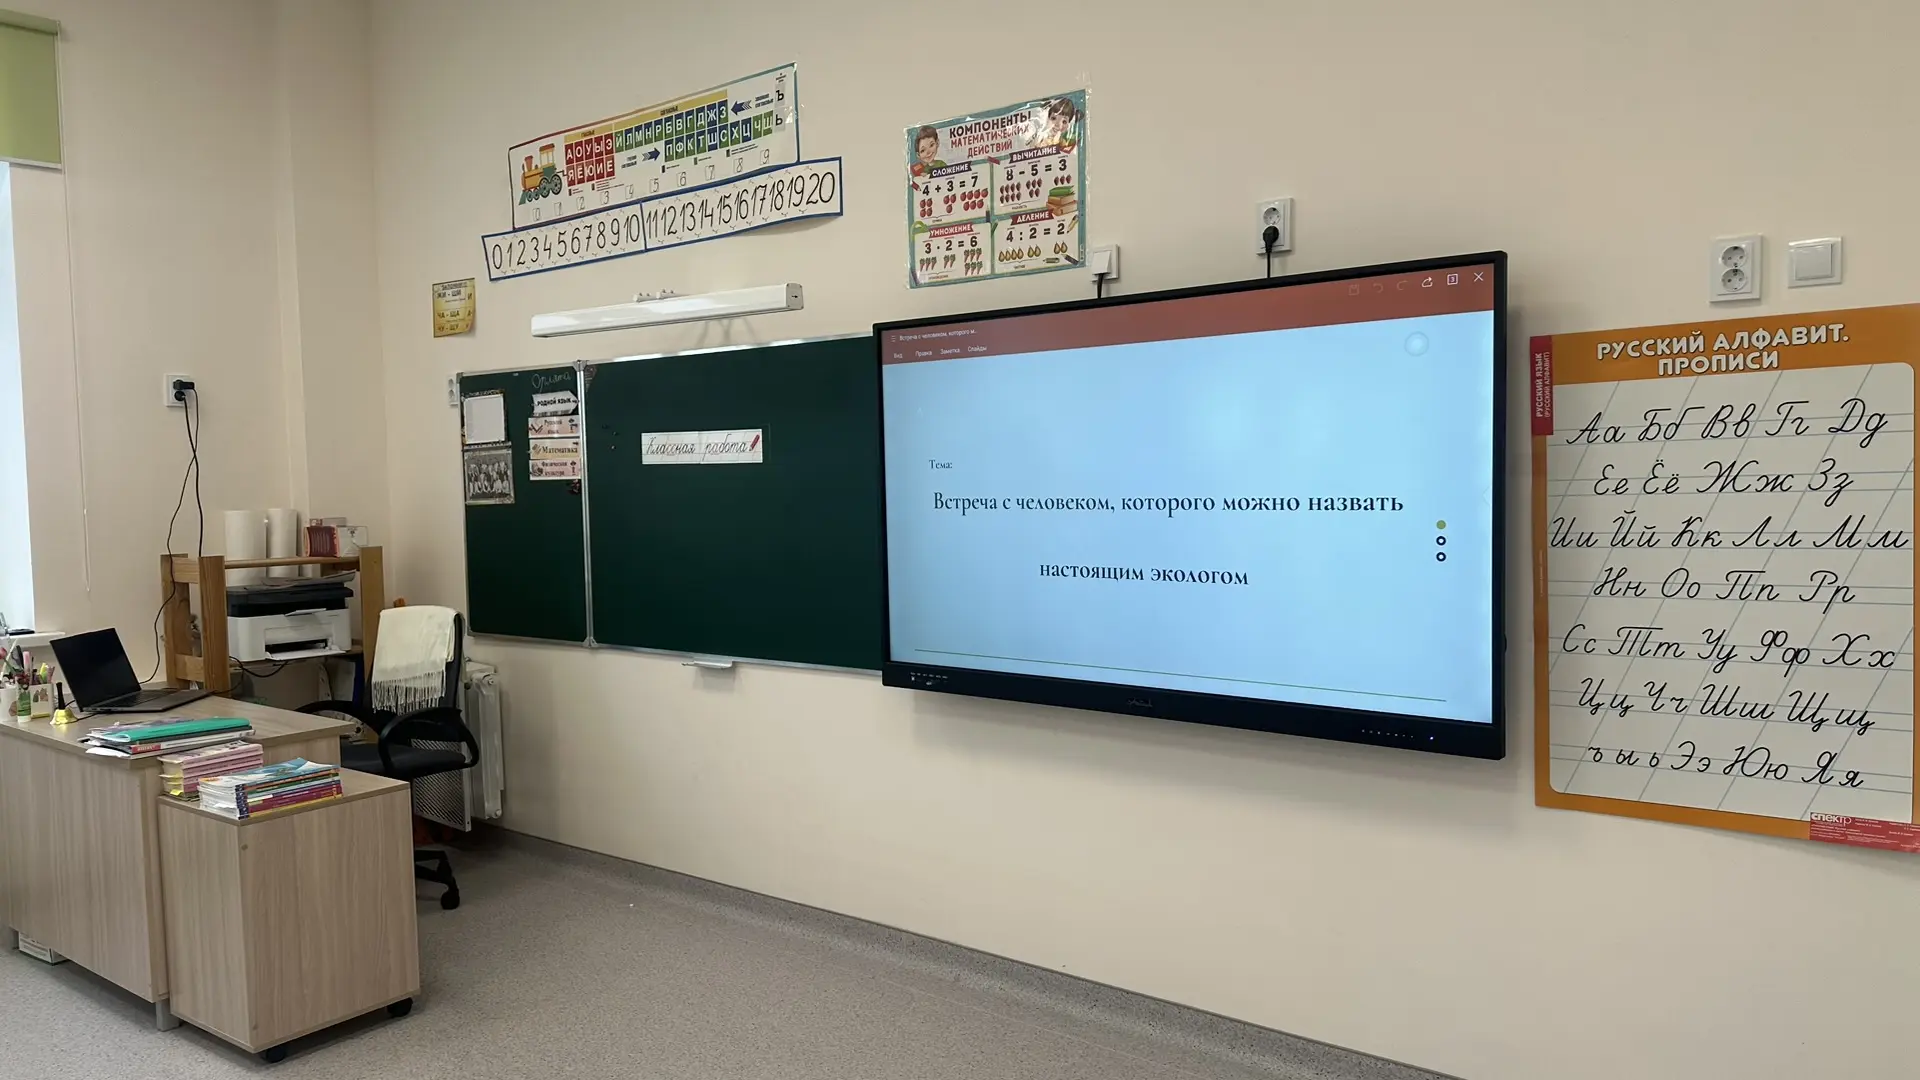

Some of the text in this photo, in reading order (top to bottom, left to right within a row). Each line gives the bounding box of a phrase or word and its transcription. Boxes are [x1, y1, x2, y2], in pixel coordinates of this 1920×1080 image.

[950, 111, 1031, 138] КОМПОНЕНТЫ
[951, 123, 1030, 149] МАТЕМАТИЧЕСКИХ
[967, 139, 1013, 159] ДЕЙСТВИЙ
[1012, 146, 1057, 161] ВЫЧИТАНИЕ
[932, 163, 969, 177] СЛОЖЕНИЕ
[1006, 168, 1014, 181] 8
[1031, 164, 1039, 176] 5
[1059, 159, 1067, 171] 3
[922, 184, 930, 196] 4
[947, 180, 954, 192] 3
[971, 175, 978, 187] 7
[492, 171, 836, 269] 0 1 2 3 4 5 6 7 8 9 10 11 12 13 14 15 16 17 18 19 20
[1016, 211, 1049, 223] ДЕЛЕНИЕ
[930, 224, 971, 236] УМНОЖЕНИЕ
[1006, 230, 1014, 242] 4
[1029, 227, 1037, 239] 2
[925, 242, 932, 254] 3
[945, 240, 953, 251] 2
[970, 236, 977, 247] 6
[1597, 323, 1849, 360] РУССКИЙ АЛФАВИТ.
[915, 350, 933, 358] Правка
[1658, 351, 1779, 376] ПРОПИСИ
[1535, 353, 1543, 418] РУССКИЙ ЯЗЫК
[537, 397, 557, 406] РОДНОЙ
[1566, 398, 1889, 449] Аа Бб Вв Гг Дд
[541, 445, 578, 454] Математика
[646, 433, 747, 461] Классная работа
[929, 459, 953, 470] Тема:
[1593, 464, 1629, 496] Ее
[1642, 459, 1680, 495] Ёё
[1807, 457, 1854, 508] Зз
[933, 492, 1404, 518] Встреча с человеком, которого можно назвать
[1550, 516, 1599, 548] Ии
[1610, 510, 1661, 548] Йй
[1671, 515, 1723, 548] Кк
[1040, 564, 1249, 585] настоящим экологом
[1593, 566, 1856, 615] Нн Оо Пп Рр
[1562, 623, 1597, 654] Сс
[1608, 626, 1685, 658] Тт
[1697, 628, 1738, 674] Уу
[1750, 629, 1811, 678] Фф
[1643, 681, 1688, 713] Чч
[1699, 683, 1775, 720] Шш
[1587, 746, 1603, 763] ъ
[1615, 748, 1640, 766] ы
[1649, 751, 1660, 768] ь
[1670, 740, 1711, 773] Ээ
[1722, 745, 1789, 780] Юю
[1811, 812, 1852, 826] спектр
